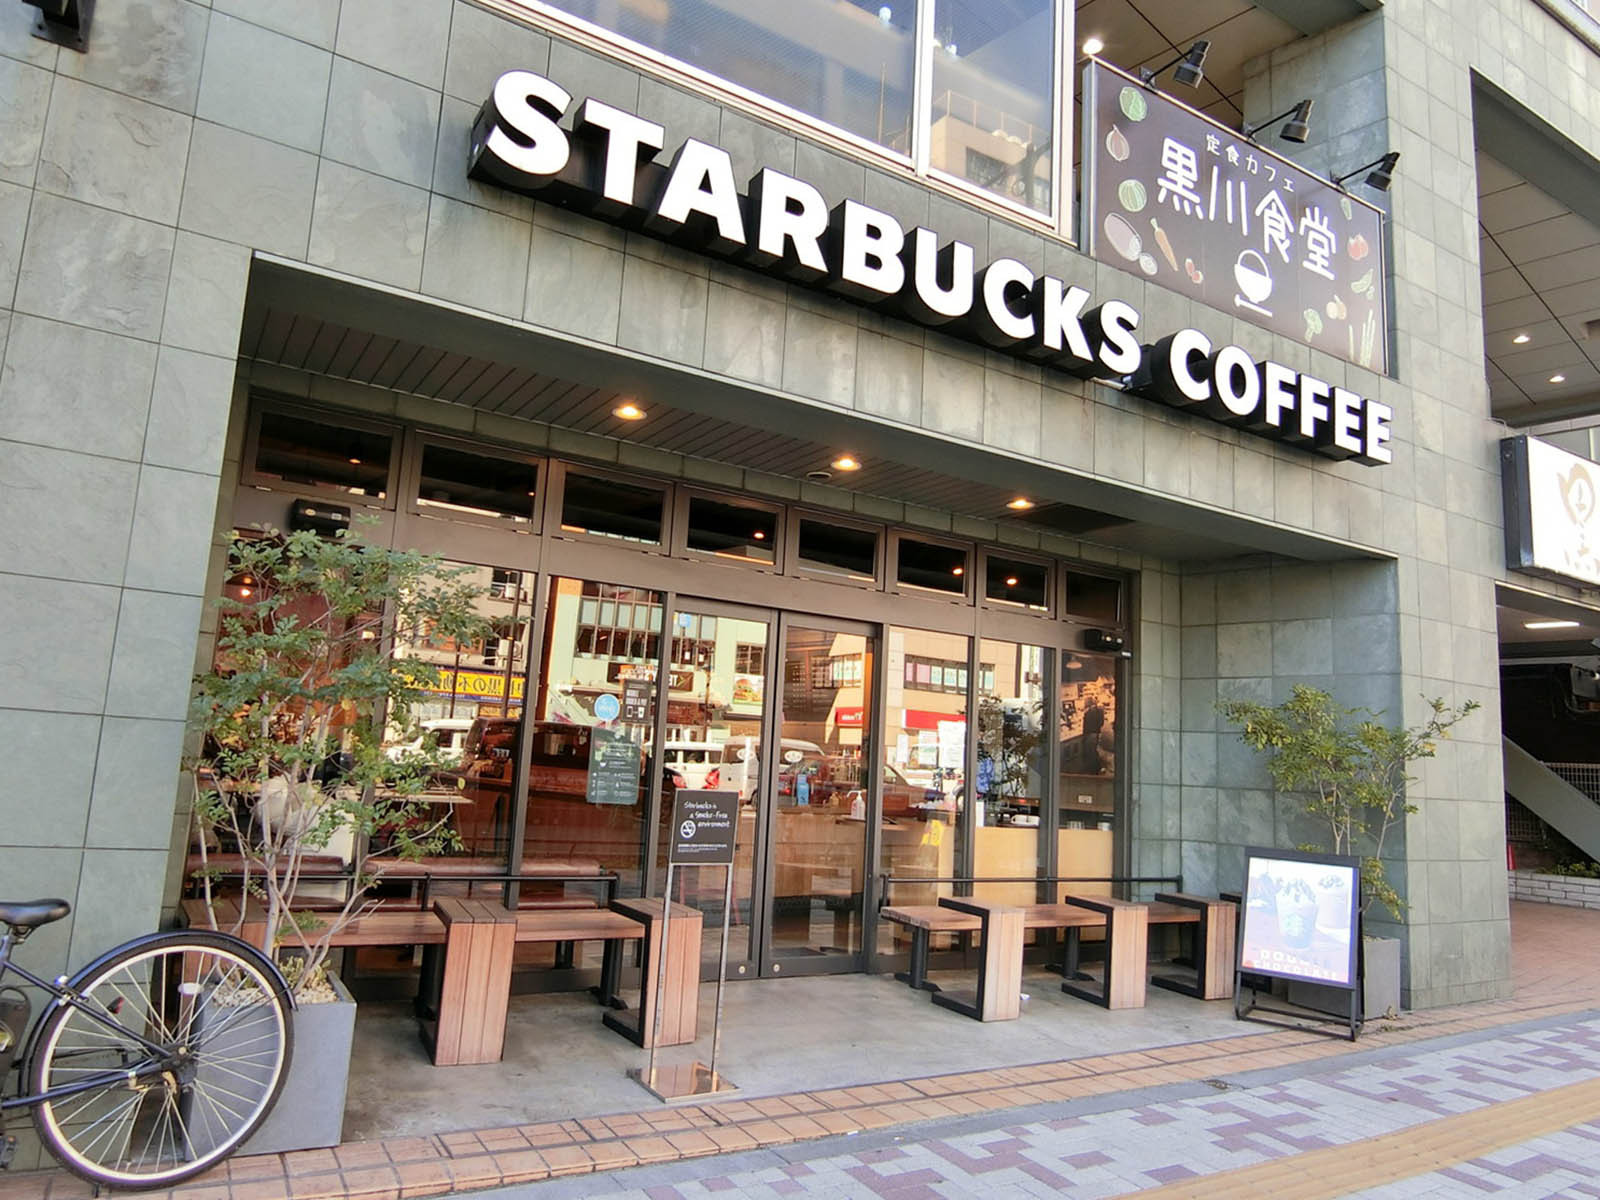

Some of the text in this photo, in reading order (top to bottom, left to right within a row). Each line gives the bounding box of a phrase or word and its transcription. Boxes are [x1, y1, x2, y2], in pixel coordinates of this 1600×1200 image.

[1156, 136, 1337, 281] 黒川食堂
[1206, 134, 1294, 193] 定食カフェ
[486, 70, 1392, 464] STARBUCKS COFFEE
